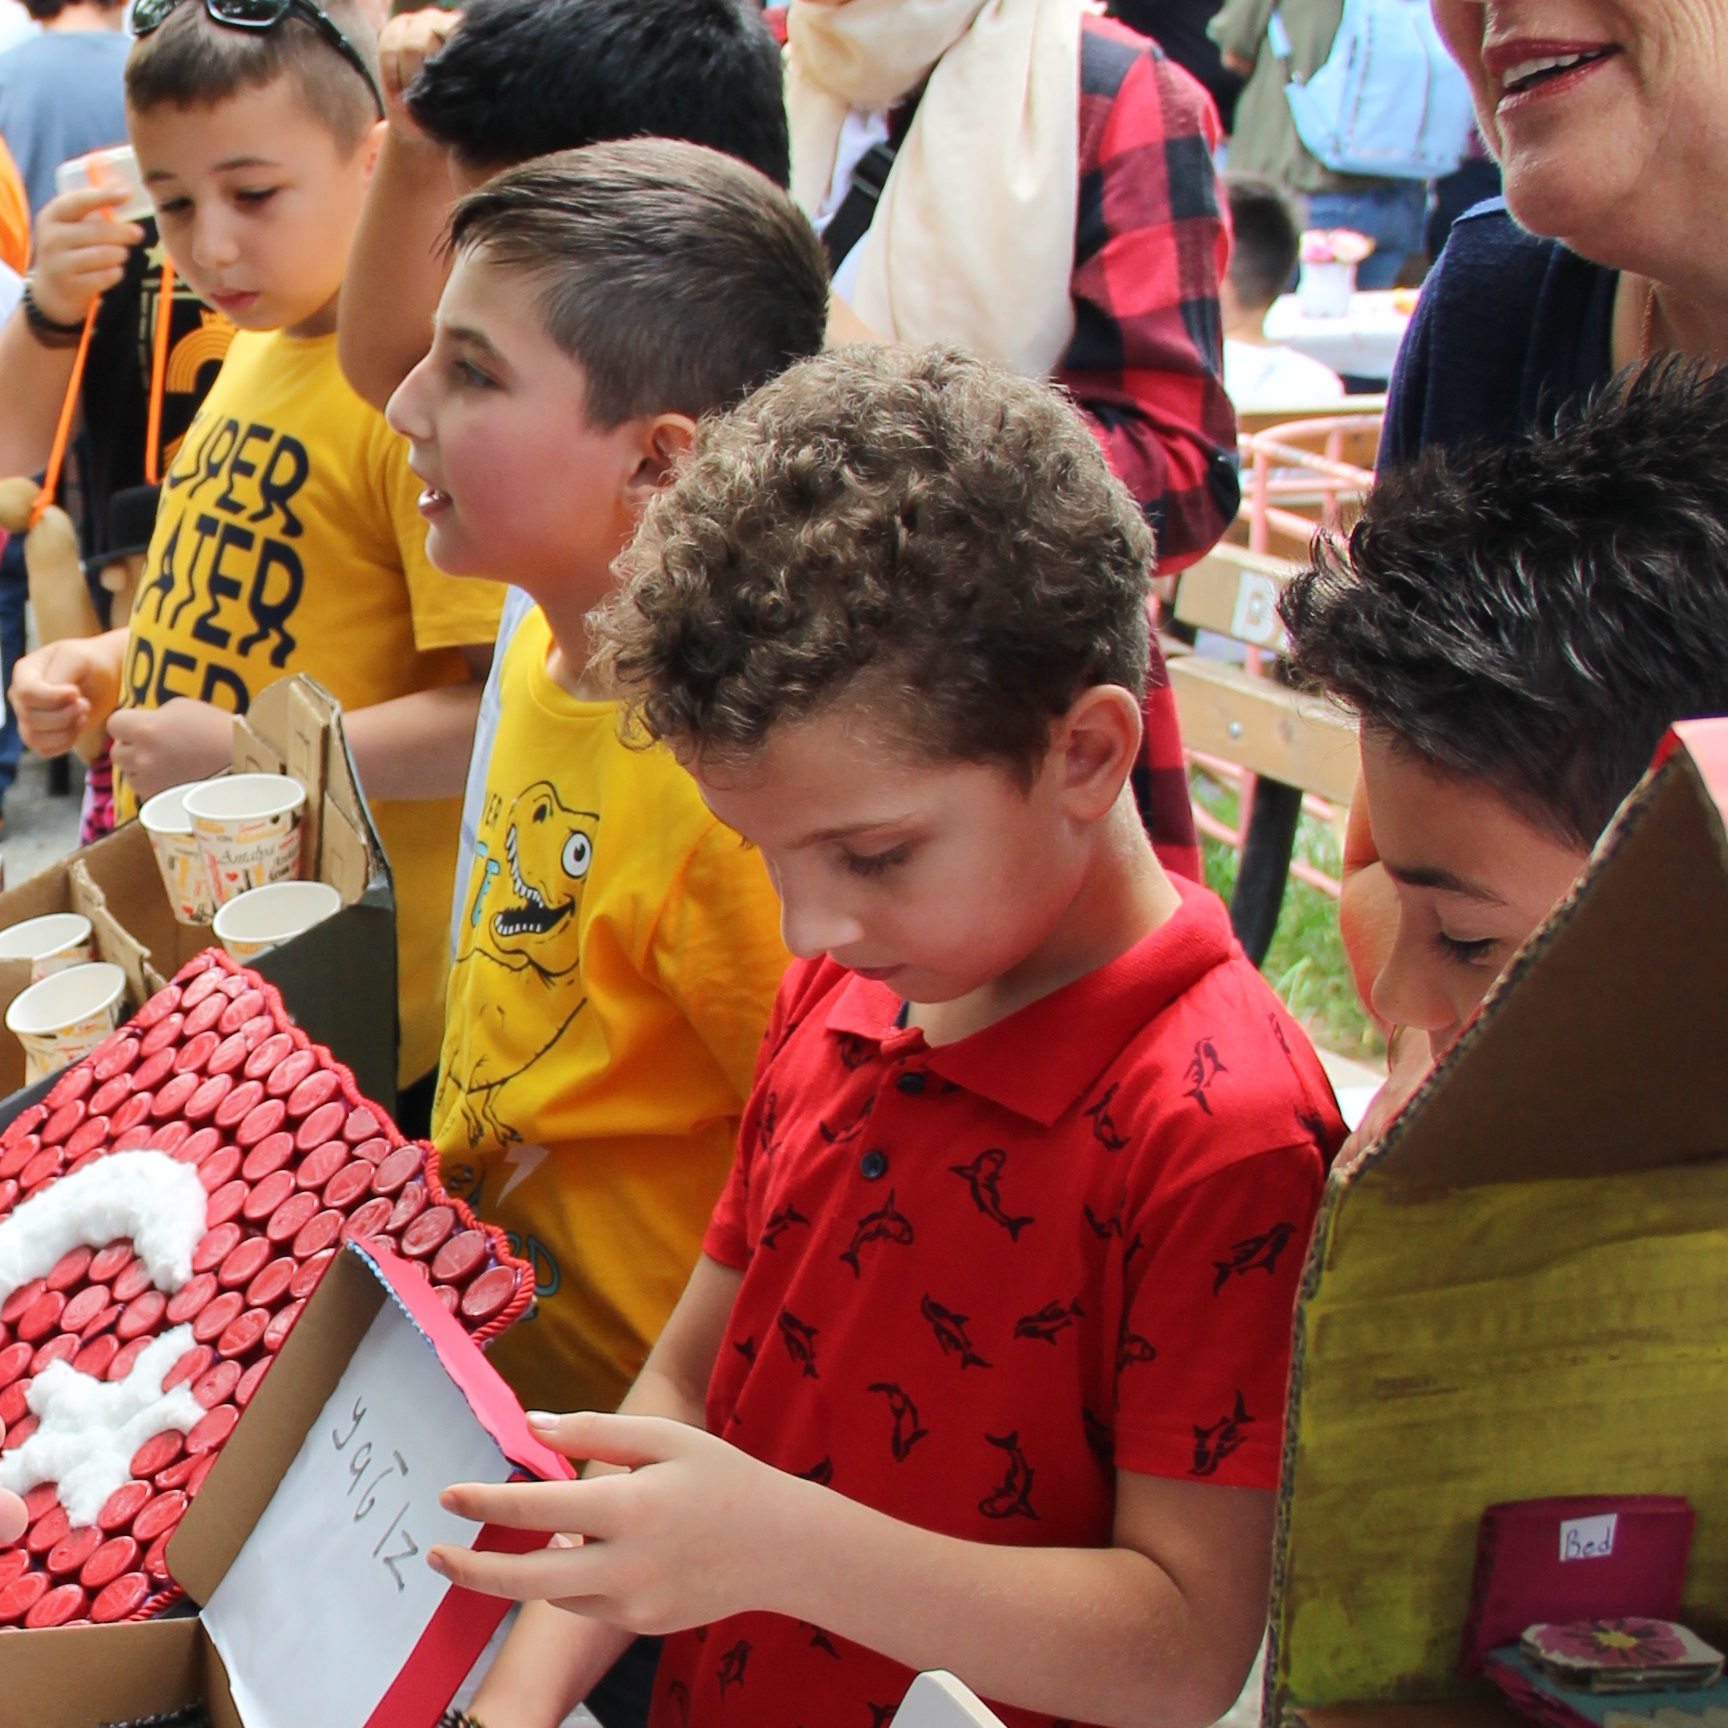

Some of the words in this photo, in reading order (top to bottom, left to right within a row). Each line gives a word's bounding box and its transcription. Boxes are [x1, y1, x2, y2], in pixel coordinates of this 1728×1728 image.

[166, 412, 309, 538] UPER
[134, 505, 304, 669] ATER
[1565, 1524, 1611, 1560] Bed
